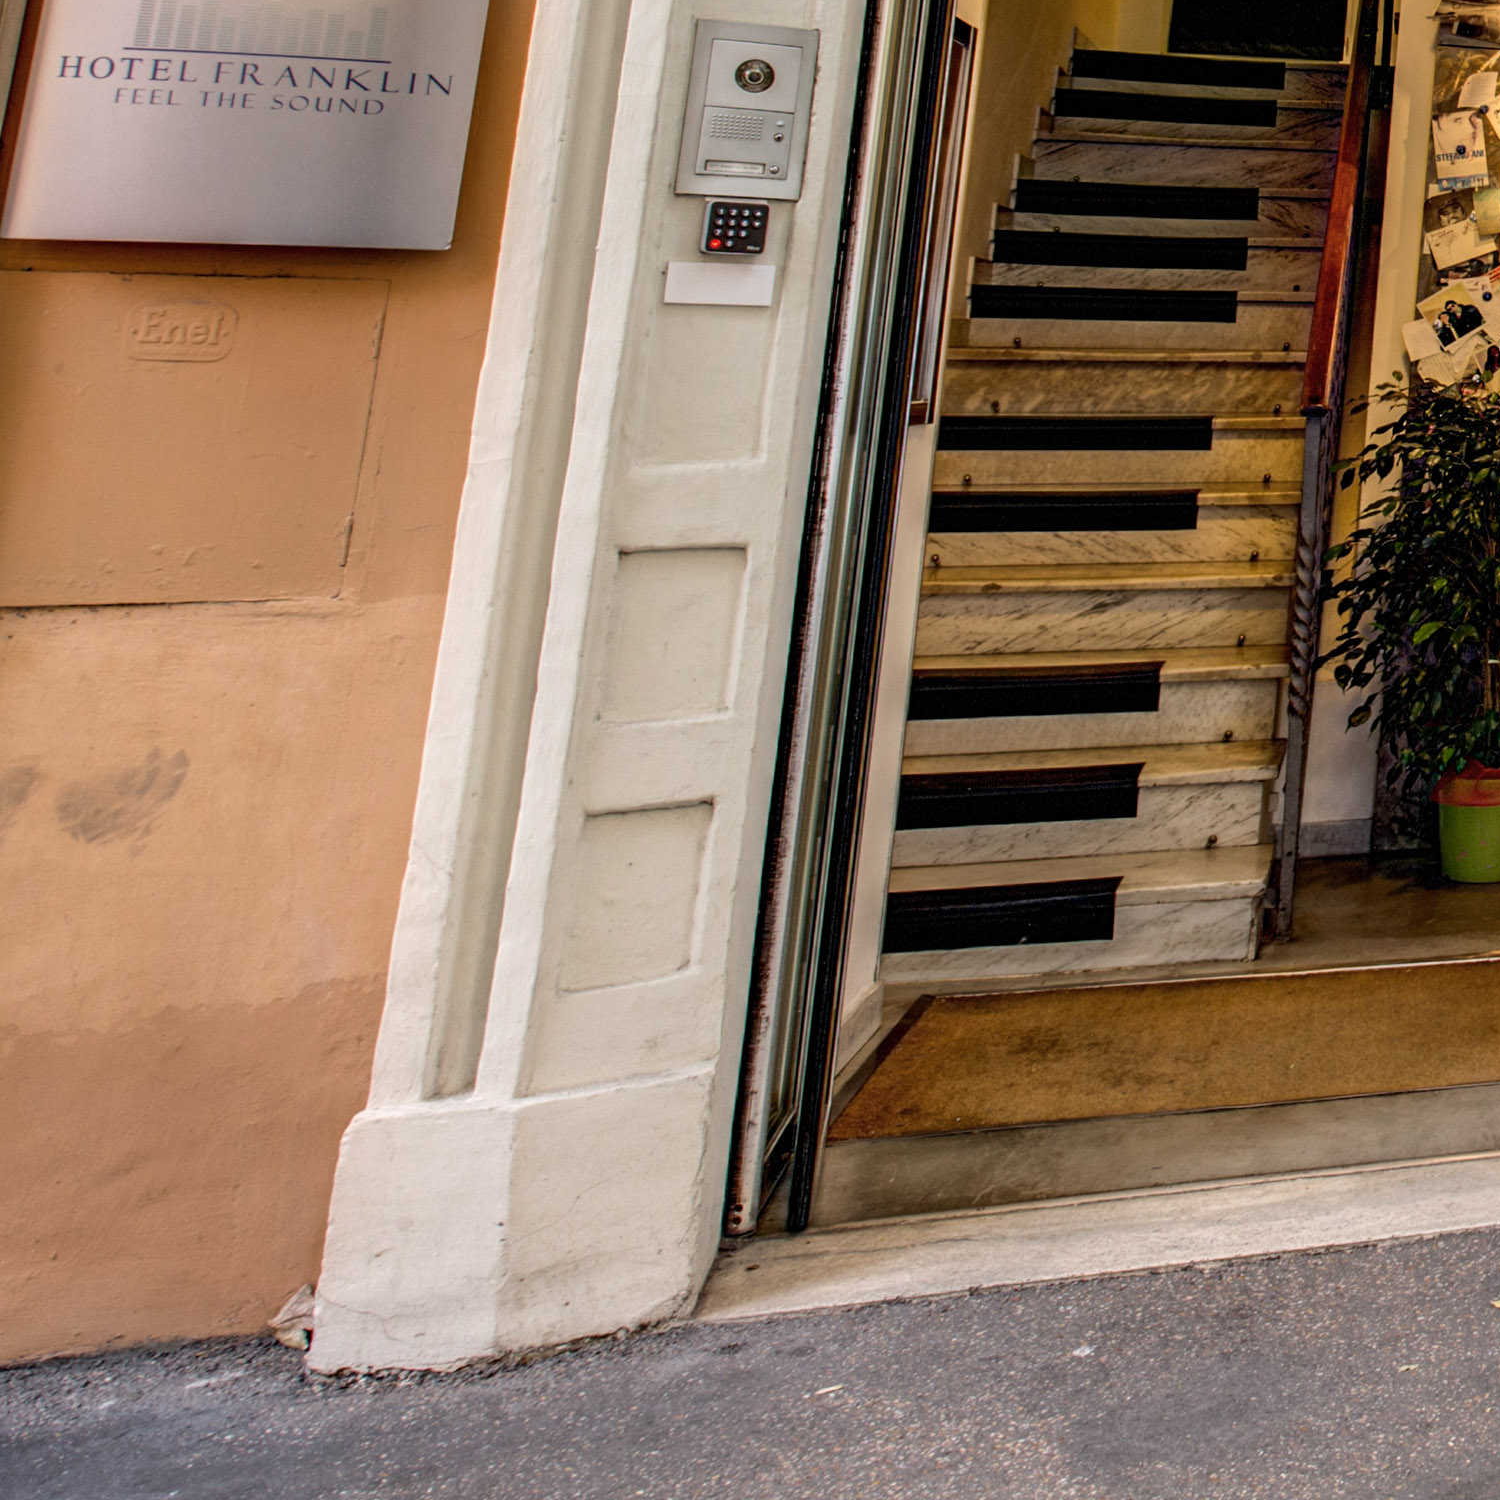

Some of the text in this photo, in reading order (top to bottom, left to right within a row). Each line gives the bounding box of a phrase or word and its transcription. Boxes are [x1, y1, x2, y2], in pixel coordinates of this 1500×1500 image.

[56, 54, 454, 97] HOTEL FRANKLIN
[114, 87, 385, 116] FEEL THE SOUND
[138, 309, 224, 346] Enel
